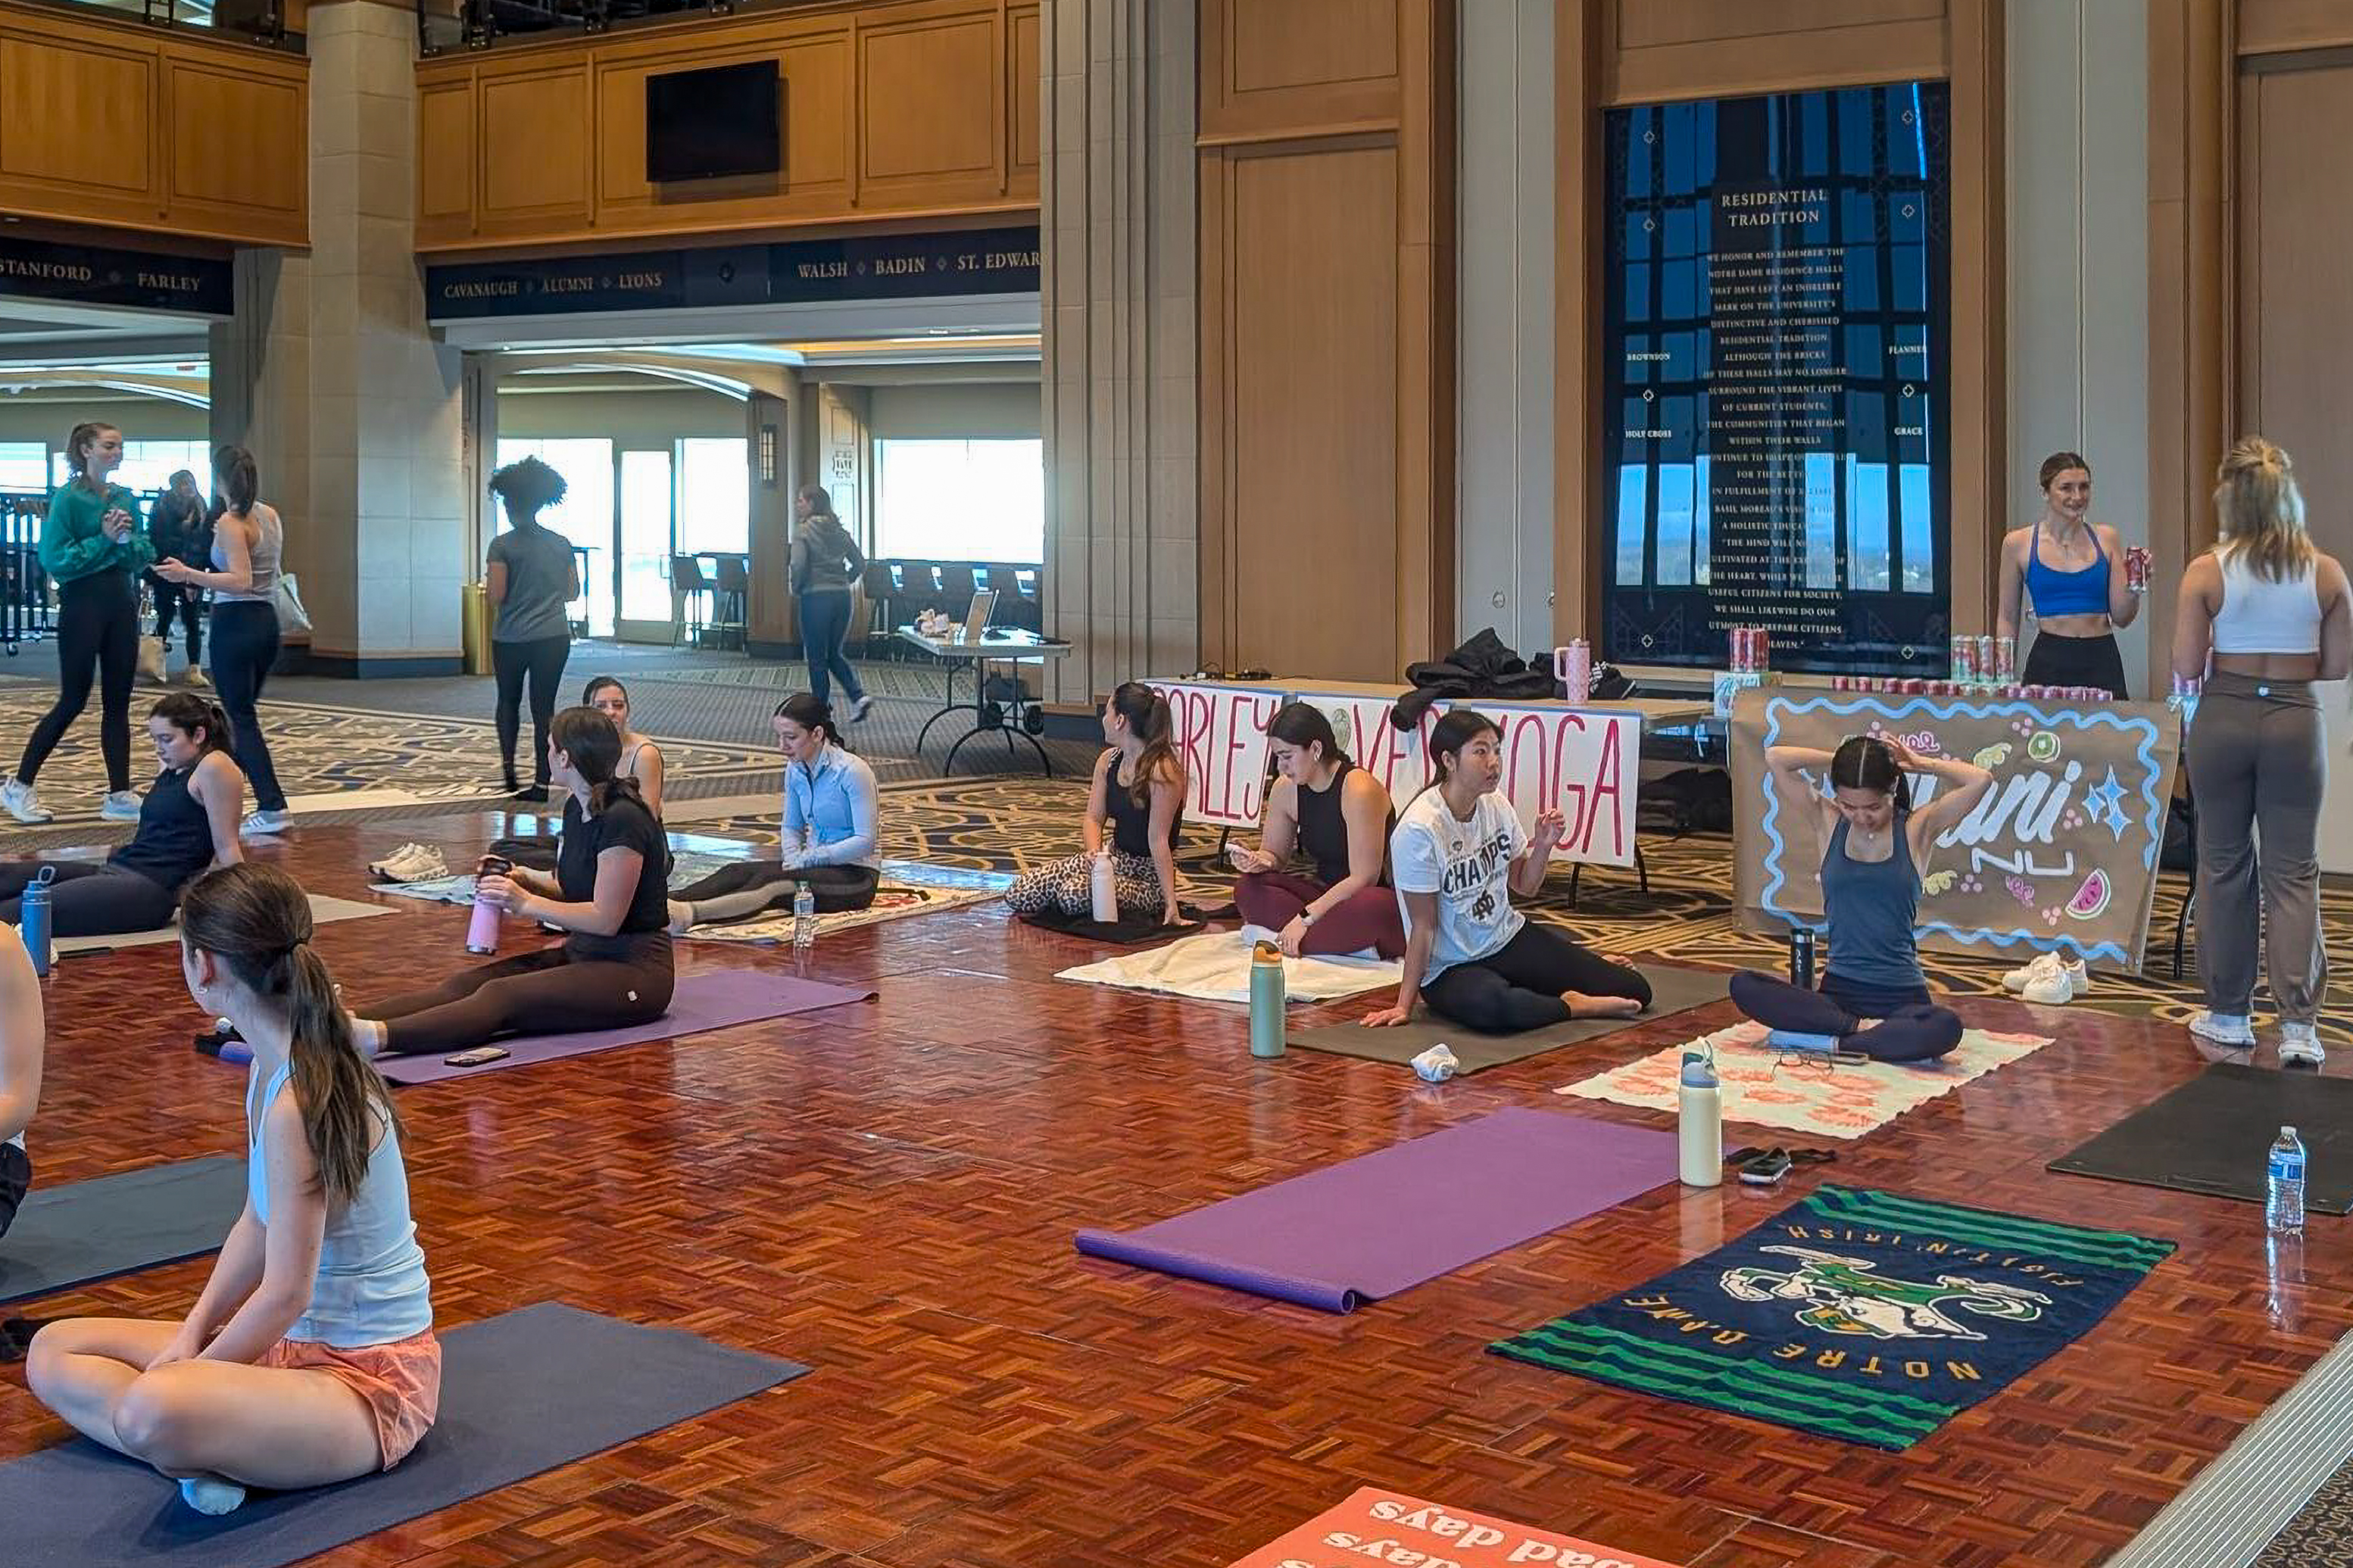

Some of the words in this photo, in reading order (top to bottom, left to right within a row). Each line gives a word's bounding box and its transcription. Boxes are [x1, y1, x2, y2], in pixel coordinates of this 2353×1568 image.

[1721, 189, 1828, 207] RESIDENTIAL
[1727, 209, 1820, 227] TRADITION
[1721, 252, 1753, 262] HONOR
[1755, 251, 1774, 260] AND
[1775, 249, 1824, 259] REMEMBER
[1826, 248, 1844, 257] THE
[798, 262, 848, 278] WALSH
[875, 257, 925, 274] BADIN
[956, 254, 979, 270] ST.
[1709, 269, 1737, 278] NOTRE
[1739, 268, 1765, 277] DAME
[1765, 267, 1813, 276] RESIDENCE
[1815, 265, 1843, 274] HALLS
[138, 272, 200, 291] FARLEY
[445, 281, 518, 299] CAVANAUGH
[541, 277, 593, 292] ALUMNI
[619, 272, 663, 289] LYONS
[1709, 286, 1732, 296] THAT
[1734, 285, 1755, 295] HAVE
[1781, 284, 1794, 292] AN
[1796, 282, 1841, 292] INDELIBLE
[1714, 303, 1738, 311] MARK
[1740, 302, 1754, 310] ON
[1756, 302, 1774, 310] THE
[1711, 319, 1765, 329] DISTINCTIVE
[1767, 318, 1787, 326] AND
[1789, 316, 1840, 326] CHERISHED
[1720, 335, 1774, 345] RESIDENTIAL
[1626, 353, 1671, 361] BROWNSON
[1724, 352, 1772, 362] ALTHOUGH
[1774, 352, 1792, 361] THE
[1794, 351, 1826, 360] BRICKS
[1718, 370, 1745, 379] THESE
[1747, 369, 1773, 379] HALLS
[1795, 369, 1808, 377] NO
[1708, 387, 1756, 396] SURROUND
[1758, 386, 1776, 395] THE
[1777, 385, 1817, 394] VIBRANT
[1818, 385, 1843, 394] LIVES
[1721, 403, 1734, 412] OF
[1736, 402, 1777, 412] CURRENT
[1725, 419, 1788, 429] COMMUNITIES
[1790, 419, 1812, 429] THAT
[1815, 418, 1846, 428] BEGAN
[1624, 430, 1646, 438] HOLY
[1894, 426, 1923, 436] GRACE
[1728, 436, 1762, 445] WITHIN
[1751, 453, 1764, 462] TO
[1737, 469, 1754, 479] FOR
[1712, 486, 1724, 496] IN
[1724, 486, 1782, 496] FULFILLMENT
[1714, 504, 1740, 514] BASIL
[1721, 522, 1728, 531] A
[1730, 521, 1771, 531] HOLISTIC
[1746, 538, 1770, 547] MIND
[1759, 555, 1770, 564] AT
[1708, 588, 1739, 597] USEFUL
[1741, 589, 1782, 598] CITIZENS
[1783, 590, 1801, 599] FOR
[1715, 605, 1727, 614] WE
[1730, 605, 1757, 615] SHALL
[1759, 606, 1799, 616] LIKEWISE
[1800, 607, 1815, 616] DO
[1816, 608, 1837, 617] OUR
[1153, 687, 1280, 821] ARLEY
[1498, 714, 1622, 857] OGA
[1443, 834, 1511, 893] CHAMPS
[1787, 1225, 1902, 1245] IRISH
[1620, 1295, 1748, 1345] DAME
[1771, 1342, 1984, 1380] NOTRE
[1368, 1500, 1506, 1548] days
